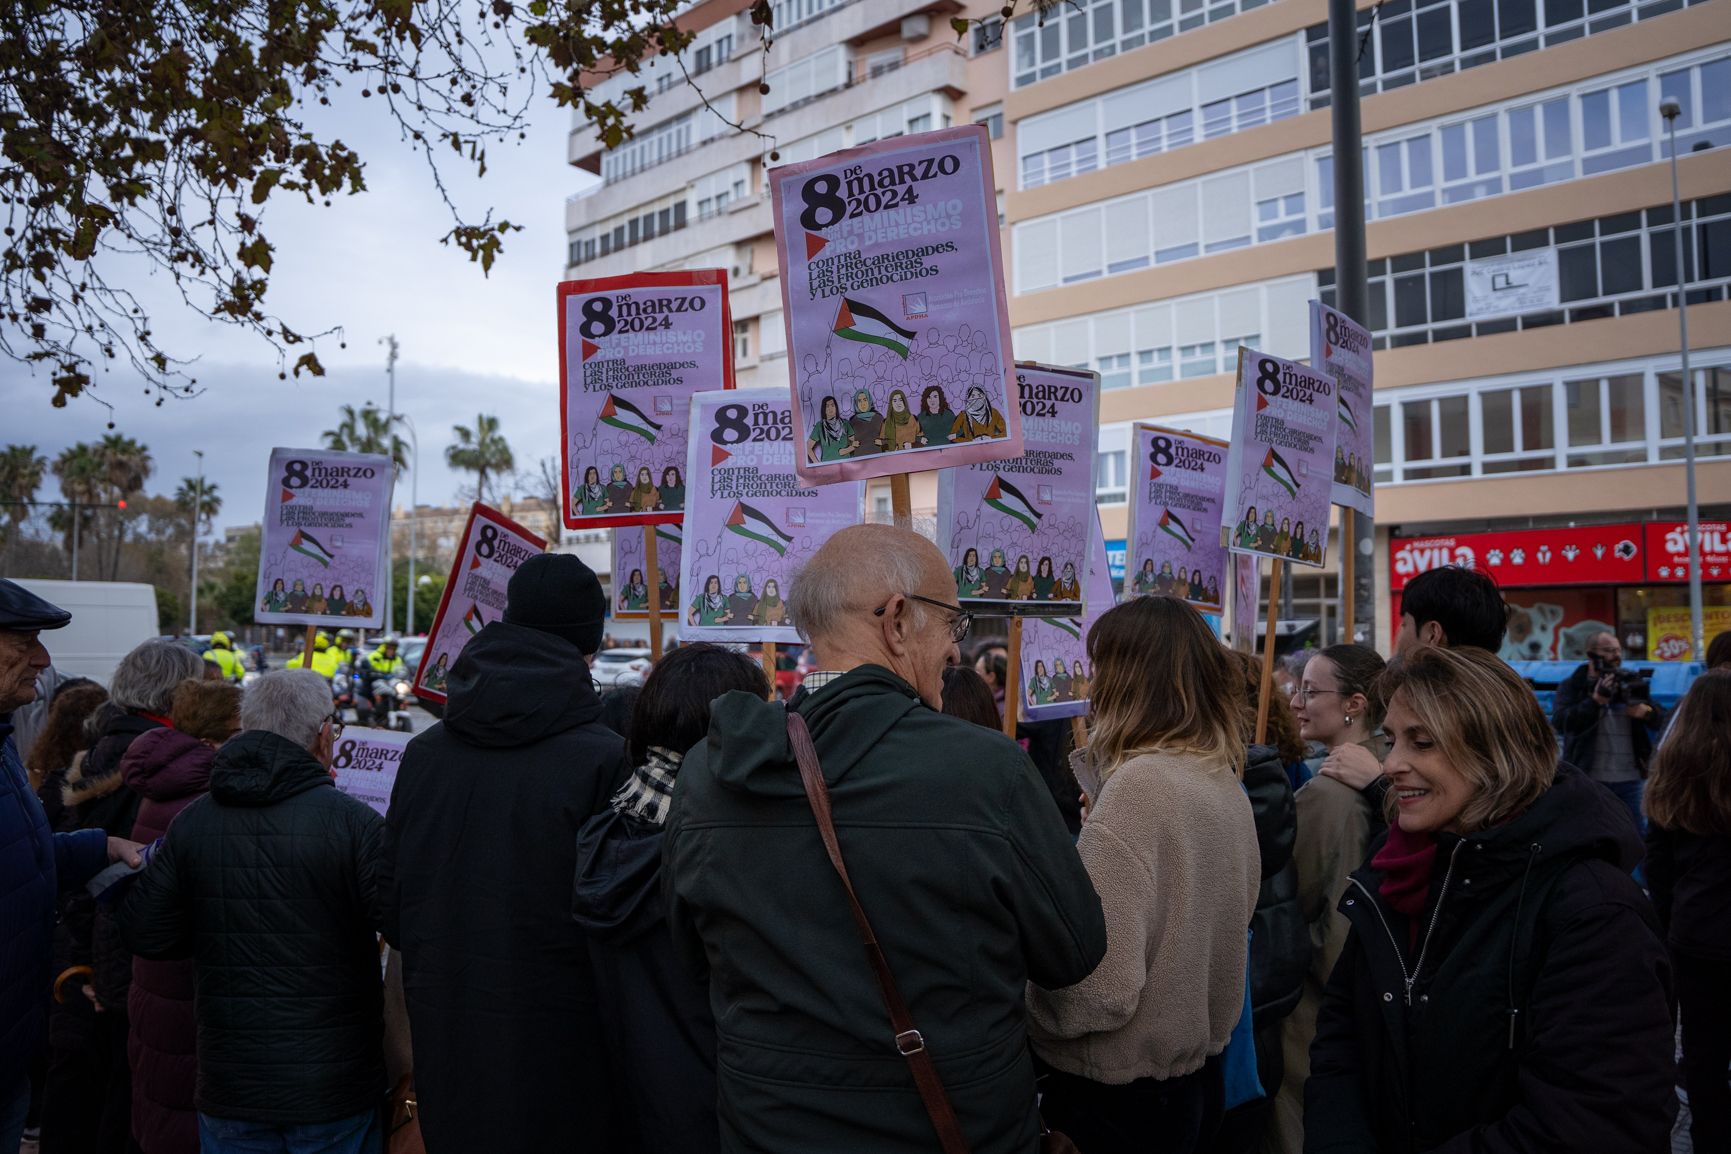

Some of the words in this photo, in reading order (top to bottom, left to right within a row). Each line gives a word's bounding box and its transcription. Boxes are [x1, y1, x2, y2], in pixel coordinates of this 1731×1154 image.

[800, 174, 847, 230] 8
[847, 185, 920, 219] 2024
[842, 199, 964, 231] FEMINISMO
[825, 235, 858, 255] PRO
[864, 214, 962, 246] DERECHOS
[579, 296, 617, 339] 8
[617, 314, 673, 335] 2024
[1325, 311, 1340, 346] 8
[612, 330, 706, 348] FEMINISMO
[1340, 337, 1359, 355] 2024
[597, 347, 625, 359] PRO
[628, 341, 704, 356] DERECHOS
[1256, 358, 1281, 396] 8
[1281, 385, 1315, 405] 2024
[1019, 399, 1058, 418] 024
[710, 403, 751, 446] 8
[752, 426, 793, 442] 202
[1021, 416, 1082, 434] MINISMO
[730, 454, 757, 466] PRO
[1149, 436, 1174, 467] 8
[281, 459, 309, 490] 8
[1174, 457, 1205, 472] 2024
[310, 478, 350, 489] 2024
[475, 524, 498, 559] 8
[1412, 538, 1456, 548] MASCOTAS
[493, 550, 519, 570] 2024
[333, 740, 357, 769] 8
[351, 758, 384, 772] 2024
